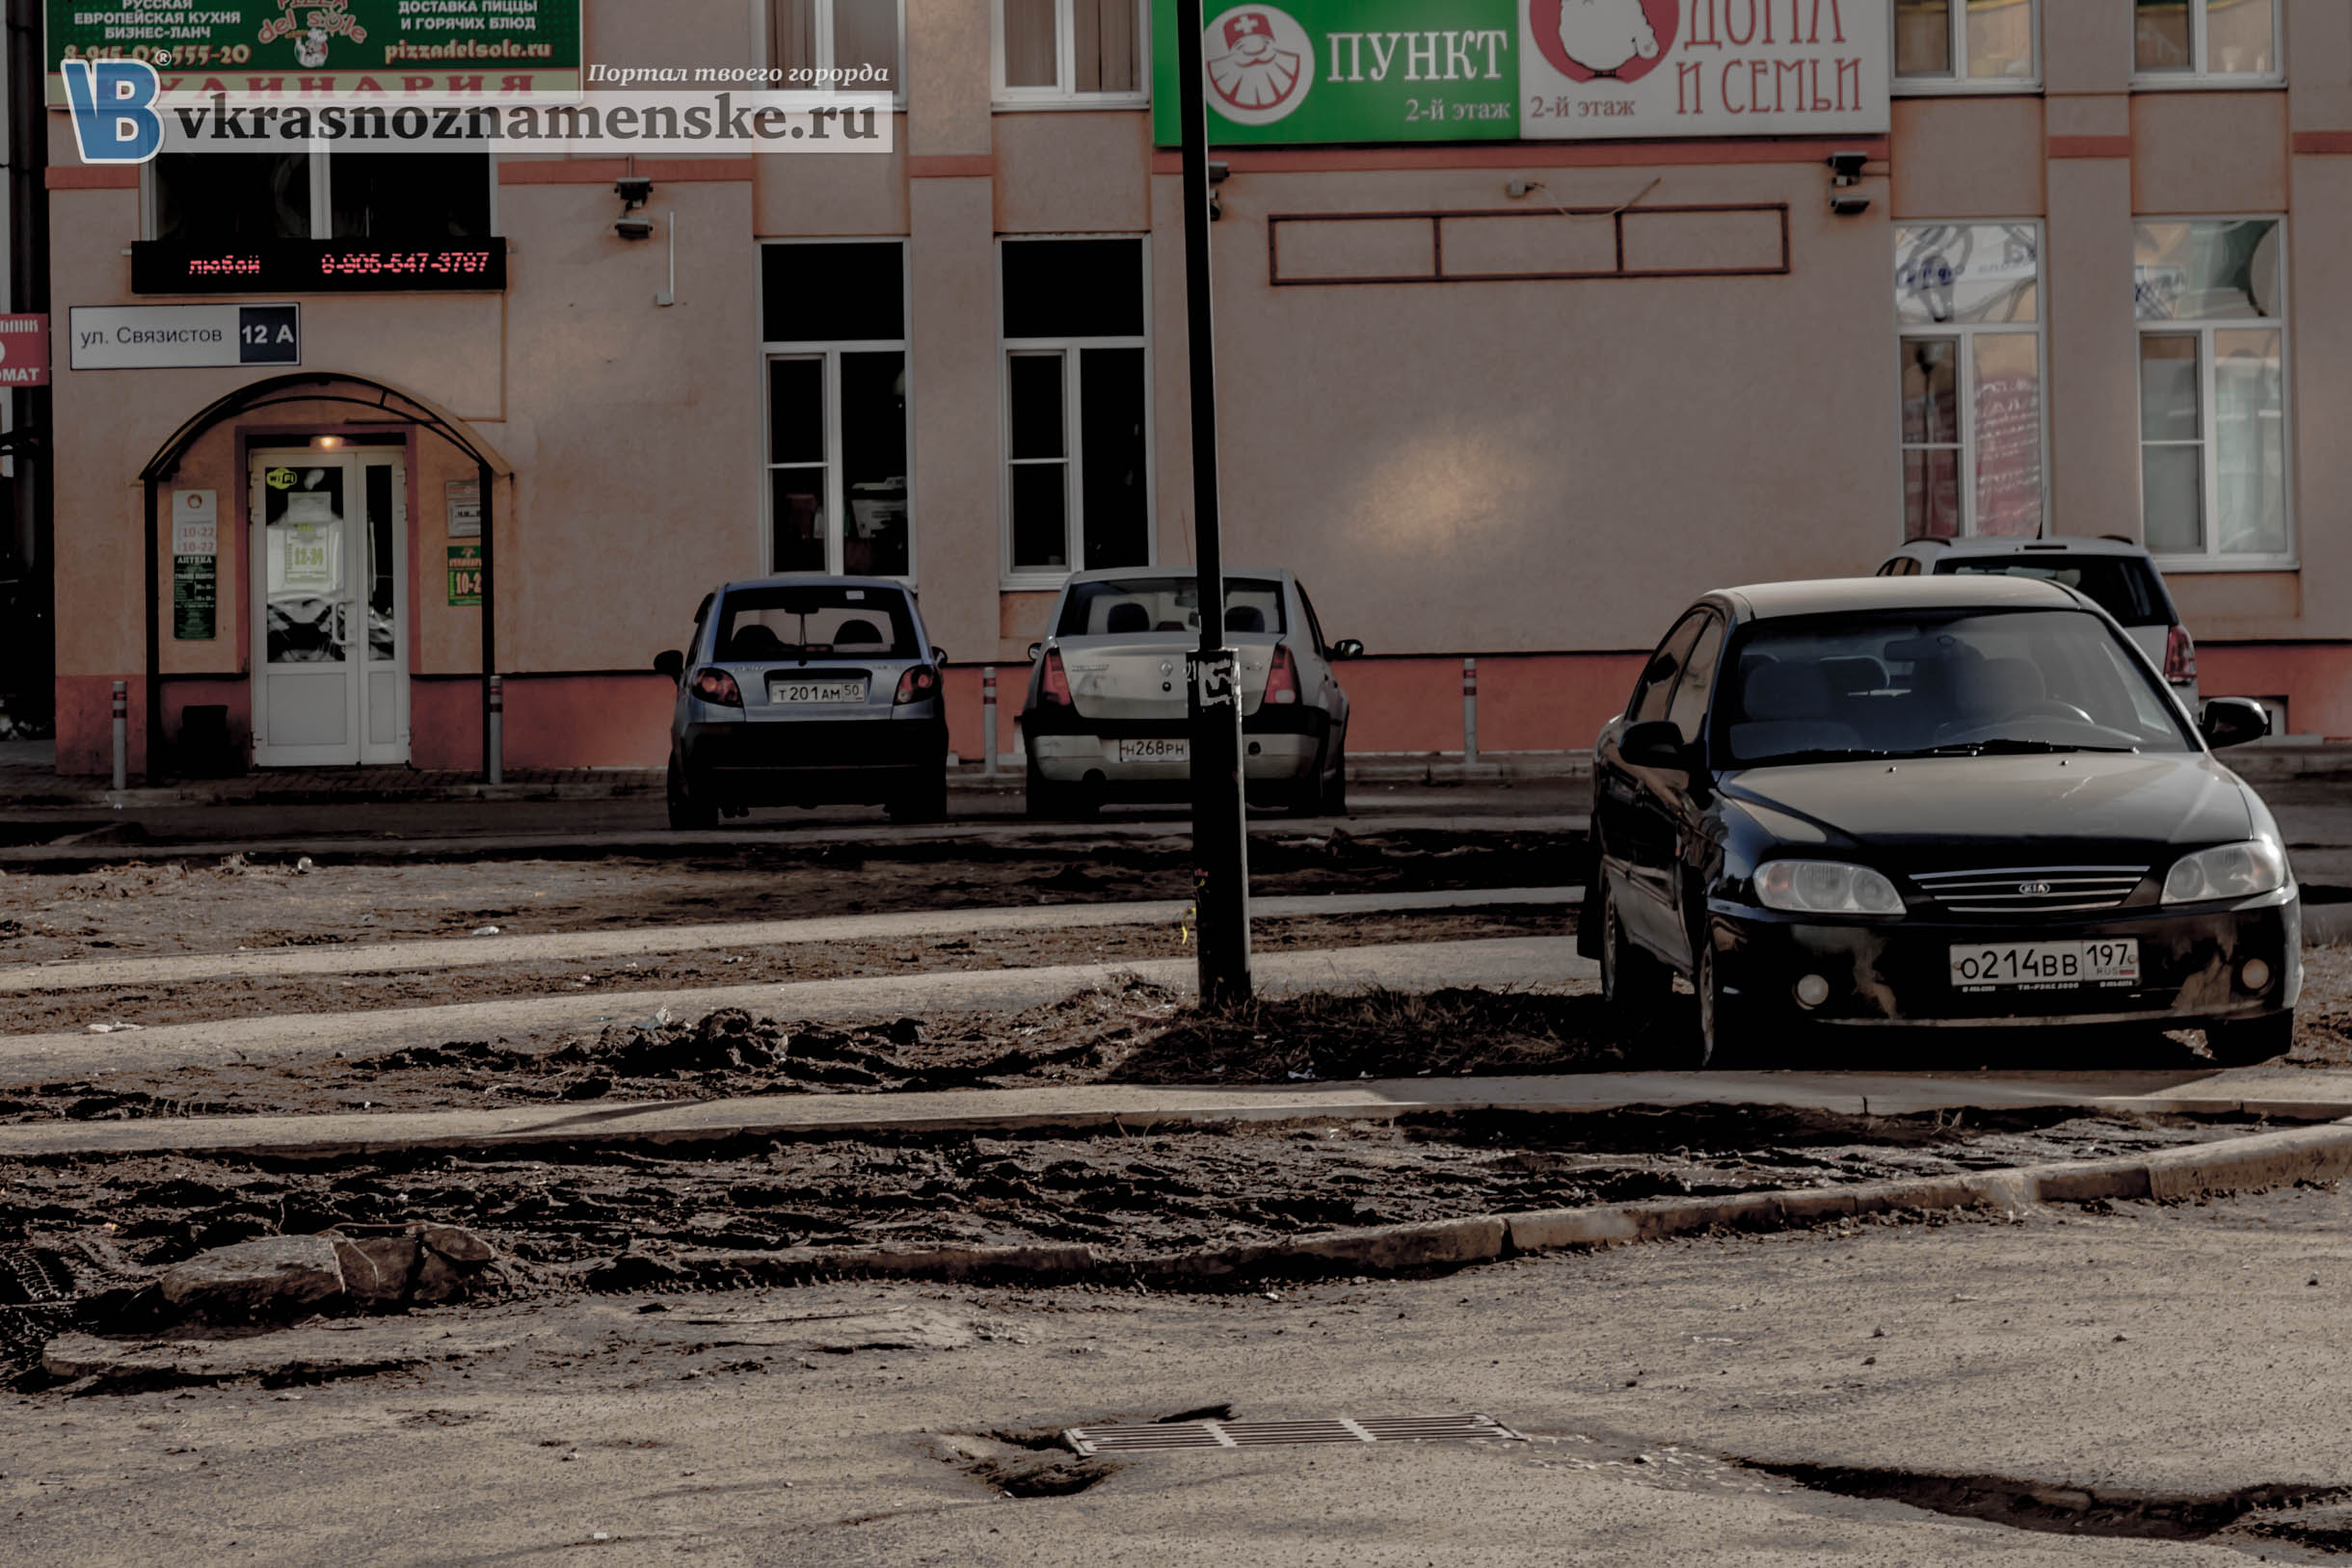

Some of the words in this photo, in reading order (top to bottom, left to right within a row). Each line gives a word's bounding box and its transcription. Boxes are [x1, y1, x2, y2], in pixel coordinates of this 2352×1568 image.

[73, 10, 185, 25] ЕВРОПЕЙСКАЯ
[188, 11, 241, 24] КУХНЯ
[398, 0, 478, 14] ДОСТАВКА
[482, 0, 538, 14] ПИЦЦЫ
[104, 26, 211, 40] БИЗНЕС-ЛАНЧ
[258, 8, 298, 44] del
[400, 17, 412, 30] И
[414, 17, 486, 30] ГОРЯЧИХ
[490, 17, 537, 30] БЛЮД
[384, 39, 552, 66] pizzadelsole.ru
[1325, 30, 1509, 82] ПУНКТ
[1675, 61, 1704, 114] И
[1722, 58, 1863, 114] СЕМЬИ
[1404, 98, 1445, 121] 2-й
[1452, 102, 1511, 120] этаж
[1530, 95, 1570, 118] 2-й
[1577, 99, 1637, 118] этаж
[188, 254, 261, 275] любой
[80, 331, 109, 349] ул.
[117, 326, 223, 345] Связистов
[241, 325, 269, 345] 12
[276, 324, 296, 344] А
[2086, 943, 2128, 967] 197
[2096, 966, 2119, 976] RUS
